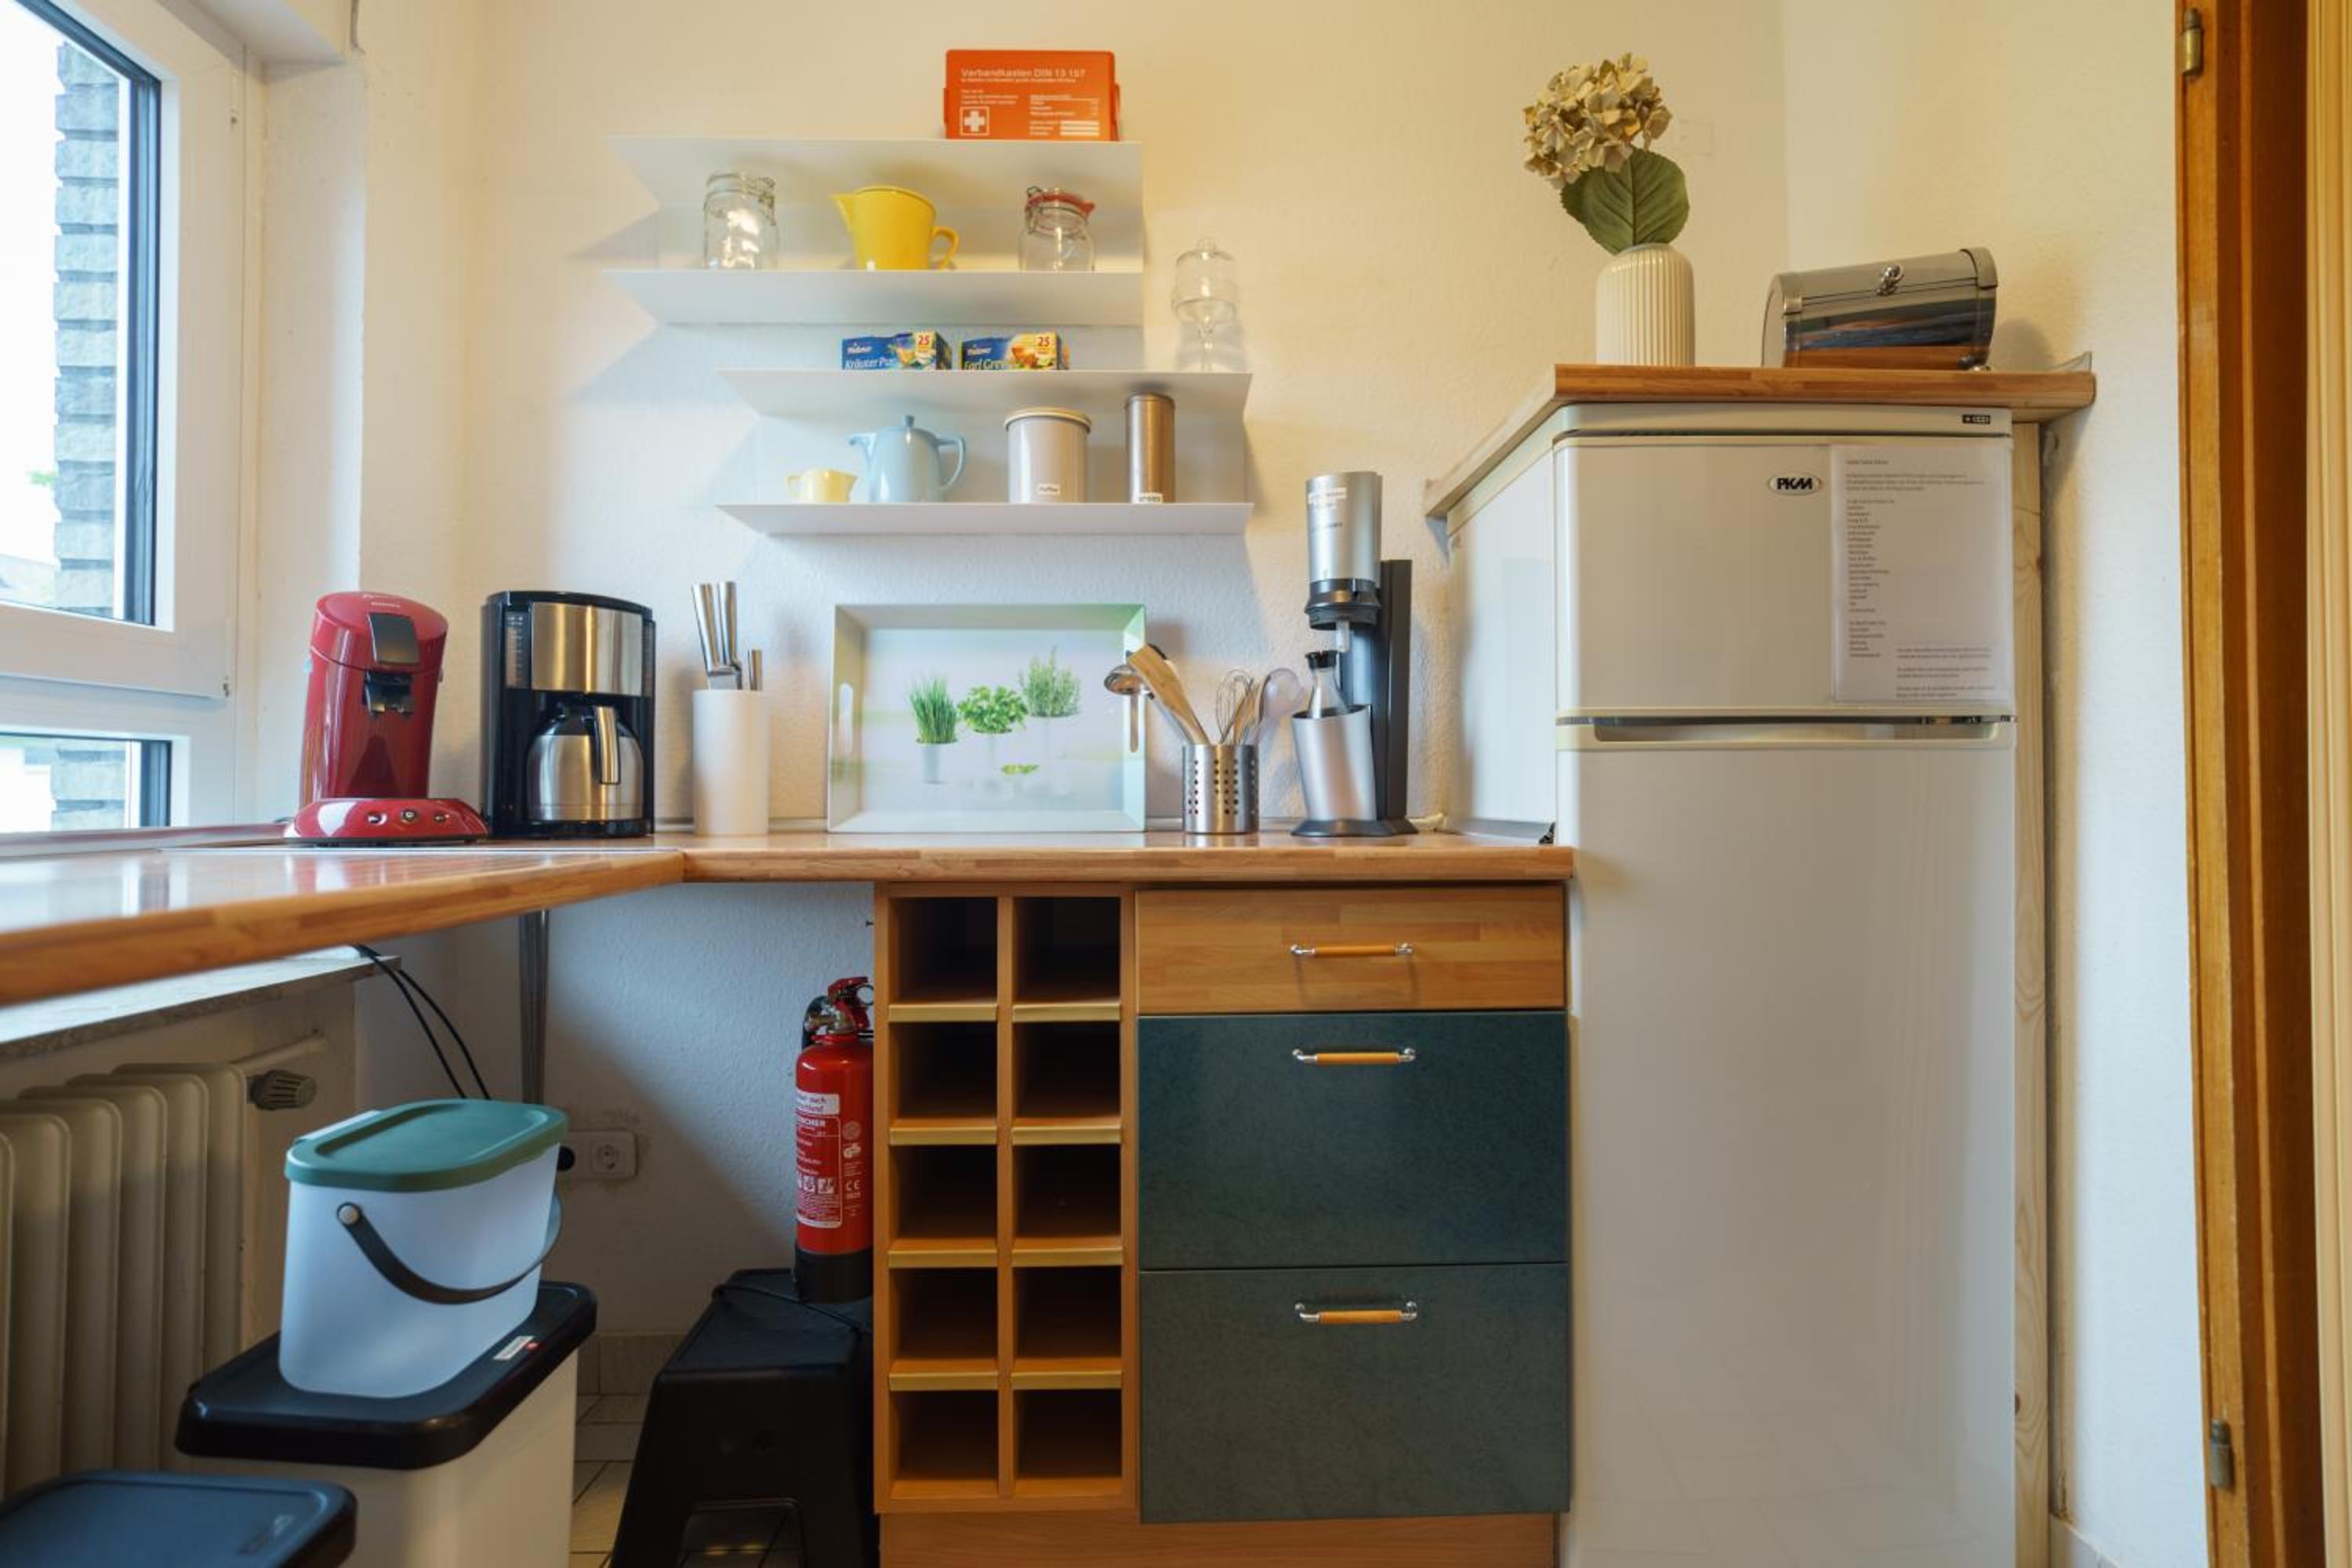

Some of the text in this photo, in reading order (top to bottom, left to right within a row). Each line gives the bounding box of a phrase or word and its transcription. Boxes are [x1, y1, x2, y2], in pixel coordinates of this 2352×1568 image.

[960, 68, 1033, 78] Verbandkasten
[1033, 68, 1052, 78] DIN
[918, 335, 930, 345] 25
[1037, 336, 1050, 347] 25
[1777, 477, 1813, 489] PKM
